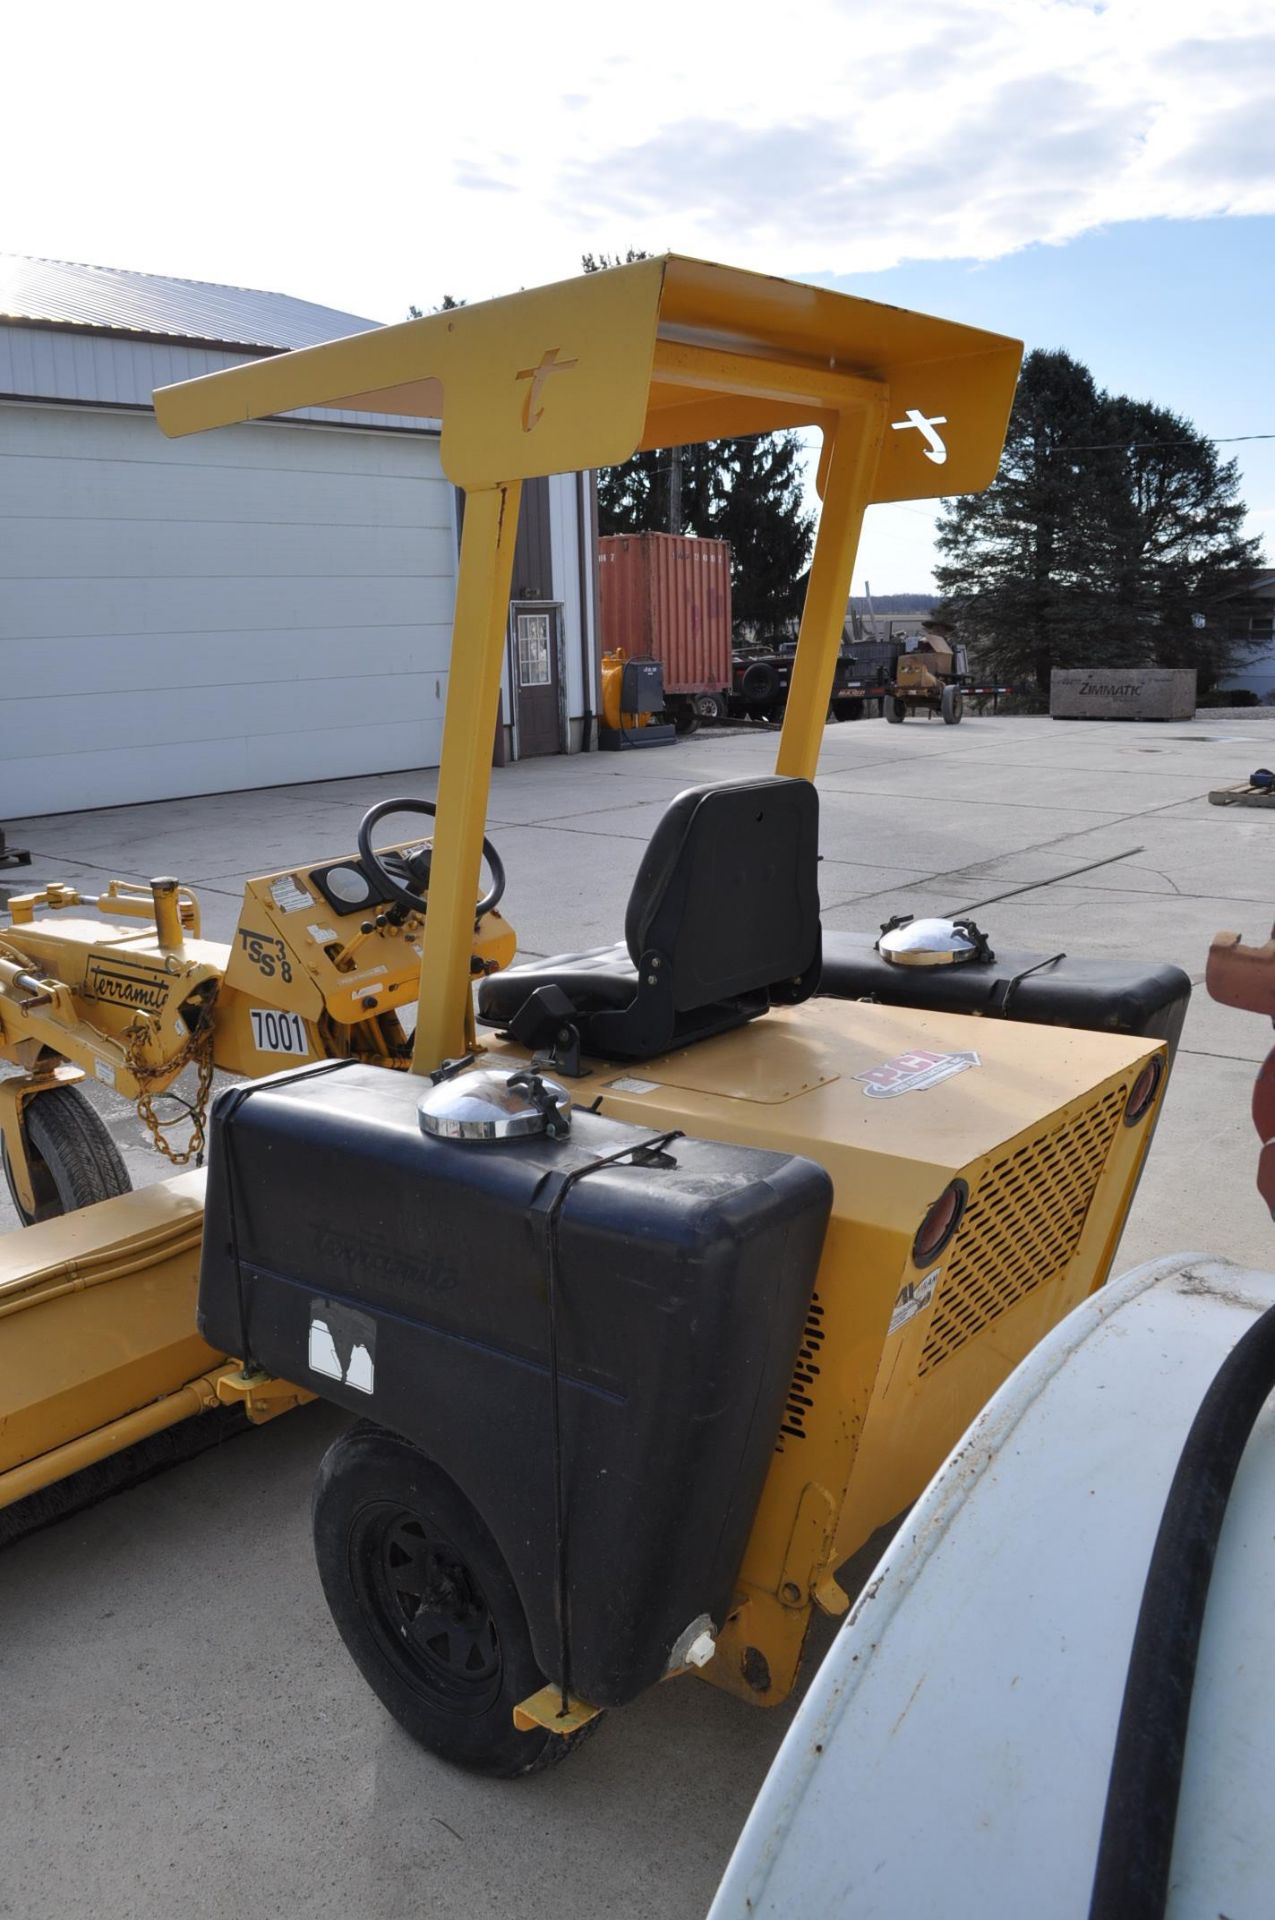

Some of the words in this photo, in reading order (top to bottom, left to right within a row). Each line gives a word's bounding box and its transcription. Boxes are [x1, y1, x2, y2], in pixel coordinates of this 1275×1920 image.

[1079, 682, 1144, 697] ZIMMATIC
[252, 1011, 306, 1053] 7001
[858, 1049, 948, 1087] PCI
